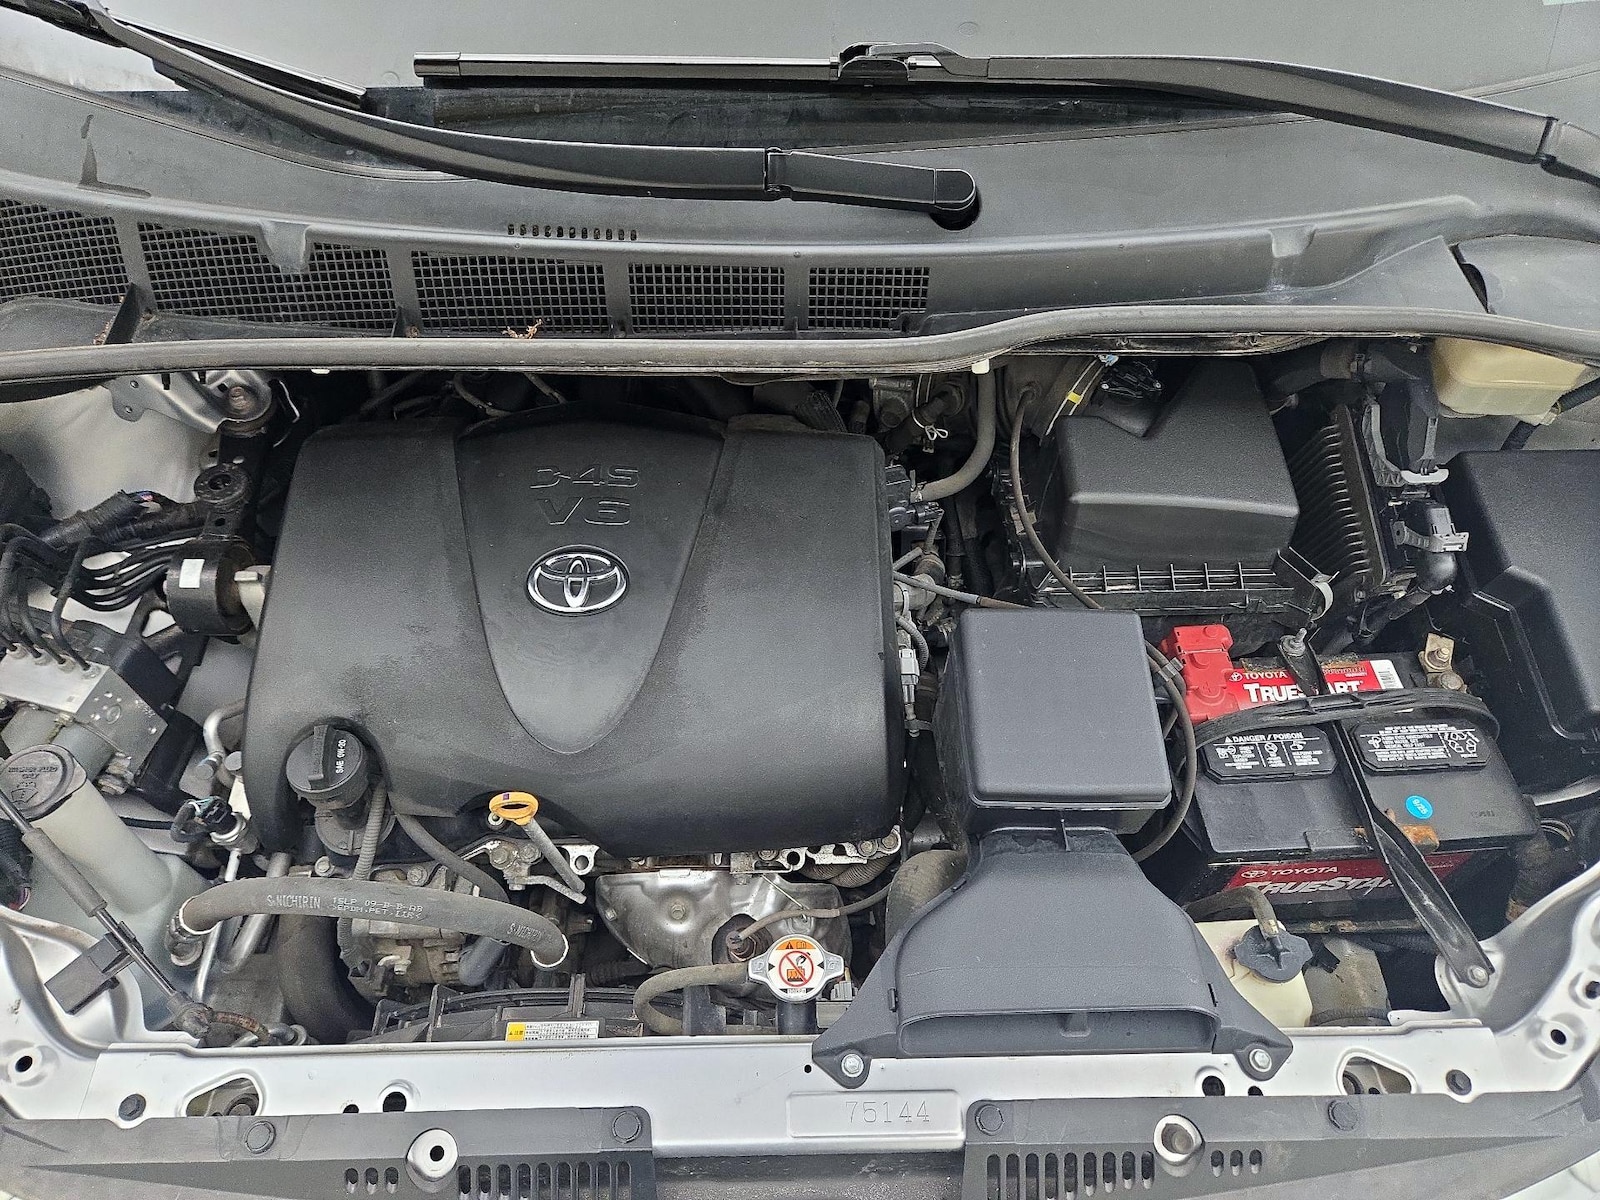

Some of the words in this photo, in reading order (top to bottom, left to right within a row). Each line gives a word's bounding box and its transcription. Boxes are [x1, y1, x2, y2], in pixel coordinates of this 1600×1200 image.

[537, 497, 631, 526] V6
[1243, 671, 1289, 681] TOYOTA
[1232, 734, 1267, 743] DANGER
[1273, 732, 1304, 741] POISON
[335, 760, 345, 774] SAE
[1271, 866, 1338, 876] TOYOTA
[845, 1101, 930, 1124] 75144
